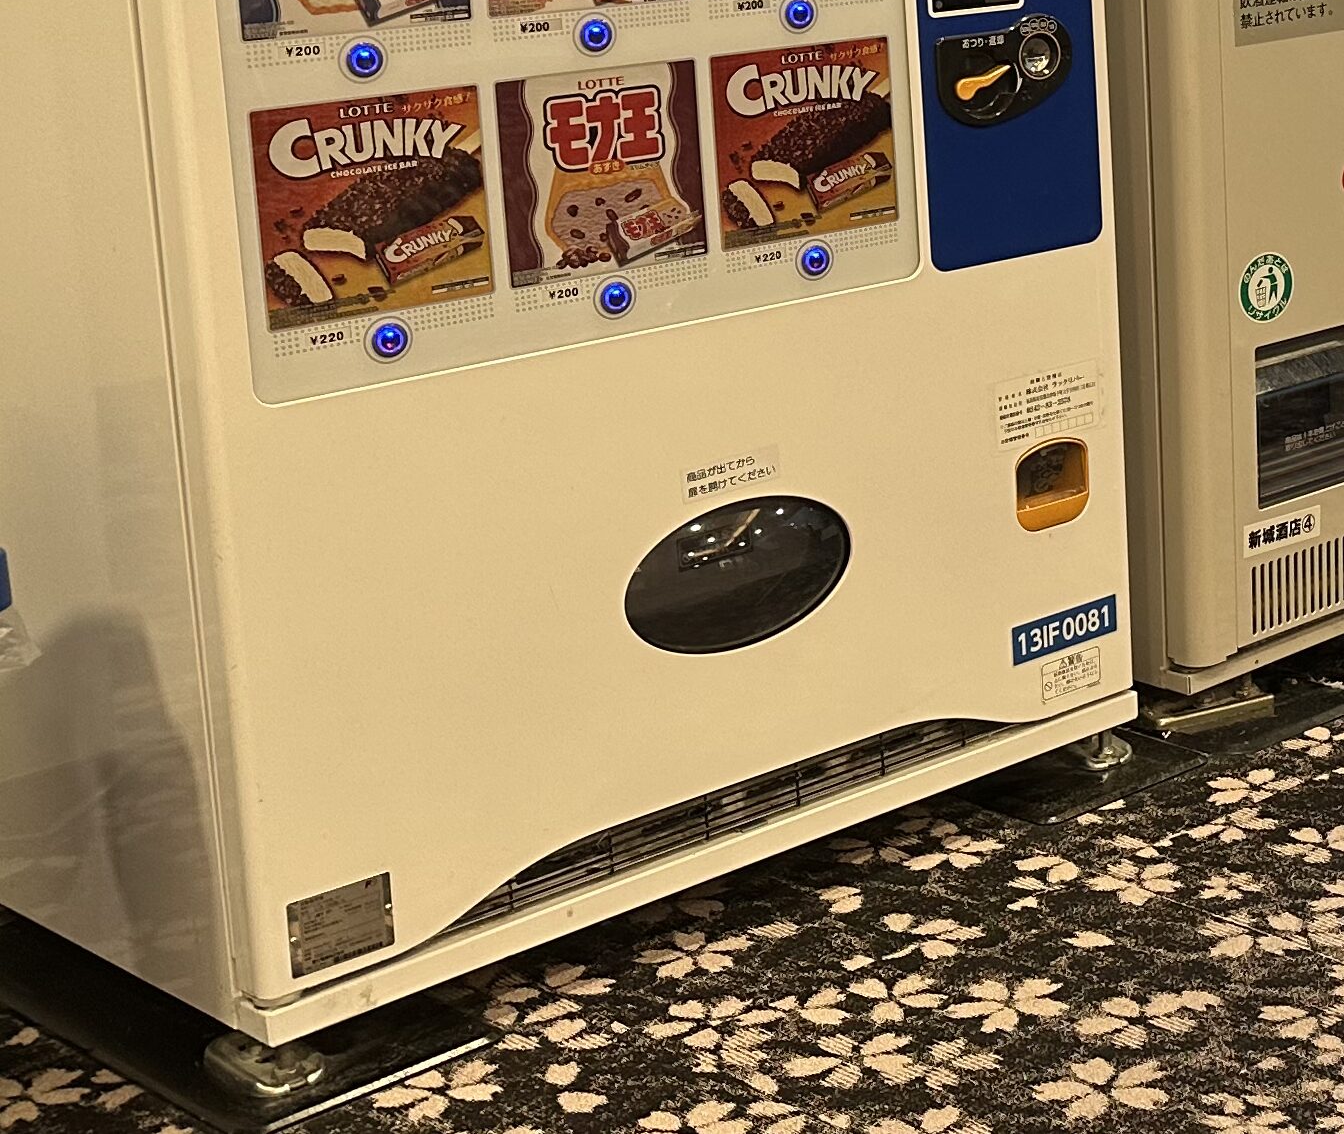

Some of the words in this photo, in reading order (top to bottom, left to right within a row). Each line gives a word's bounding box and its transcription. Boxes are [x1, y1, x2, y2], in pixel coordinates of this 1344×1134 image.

[738, 1, 764, 11] ¥200
[1240, 2, 1333, 29] 禁止されています。
[520, 22, 549, 33] ¥200
[285, 45, 320, 56] ¥200
[781, 50, 823, 64] LOTTE
[578, 76, 625, 91] LOTTE
[726, 64, 878, 116] CRUNKY
[338, 103, 393, 119] LOTTE
[544, 85, 665, 172] モナ王
[268, 117, 463, 179] CRUNKY
[331, 166, 381, 179] CHOCOLATE
[384, 163, 398, 172] ICE
[399, 161, 417, 170] BAR
[814, 163, 866, 192] CRUNKY
[621, 210, 666, 240] モナ王
[385, 227, 452, 263] CRUNKY
[756, 251, 781, 263] ¥220
[549, 287, 579, 299] ¥200
[1248, 297, 1287, 320] リサイクル
[310, 331, 344, 345] ¥220
[686, 456, 756, 483] 商品が出てから
[688, 465, 776, 498] 扉を開けてください
[1018, 605, 1109, 655] 13IF0081
